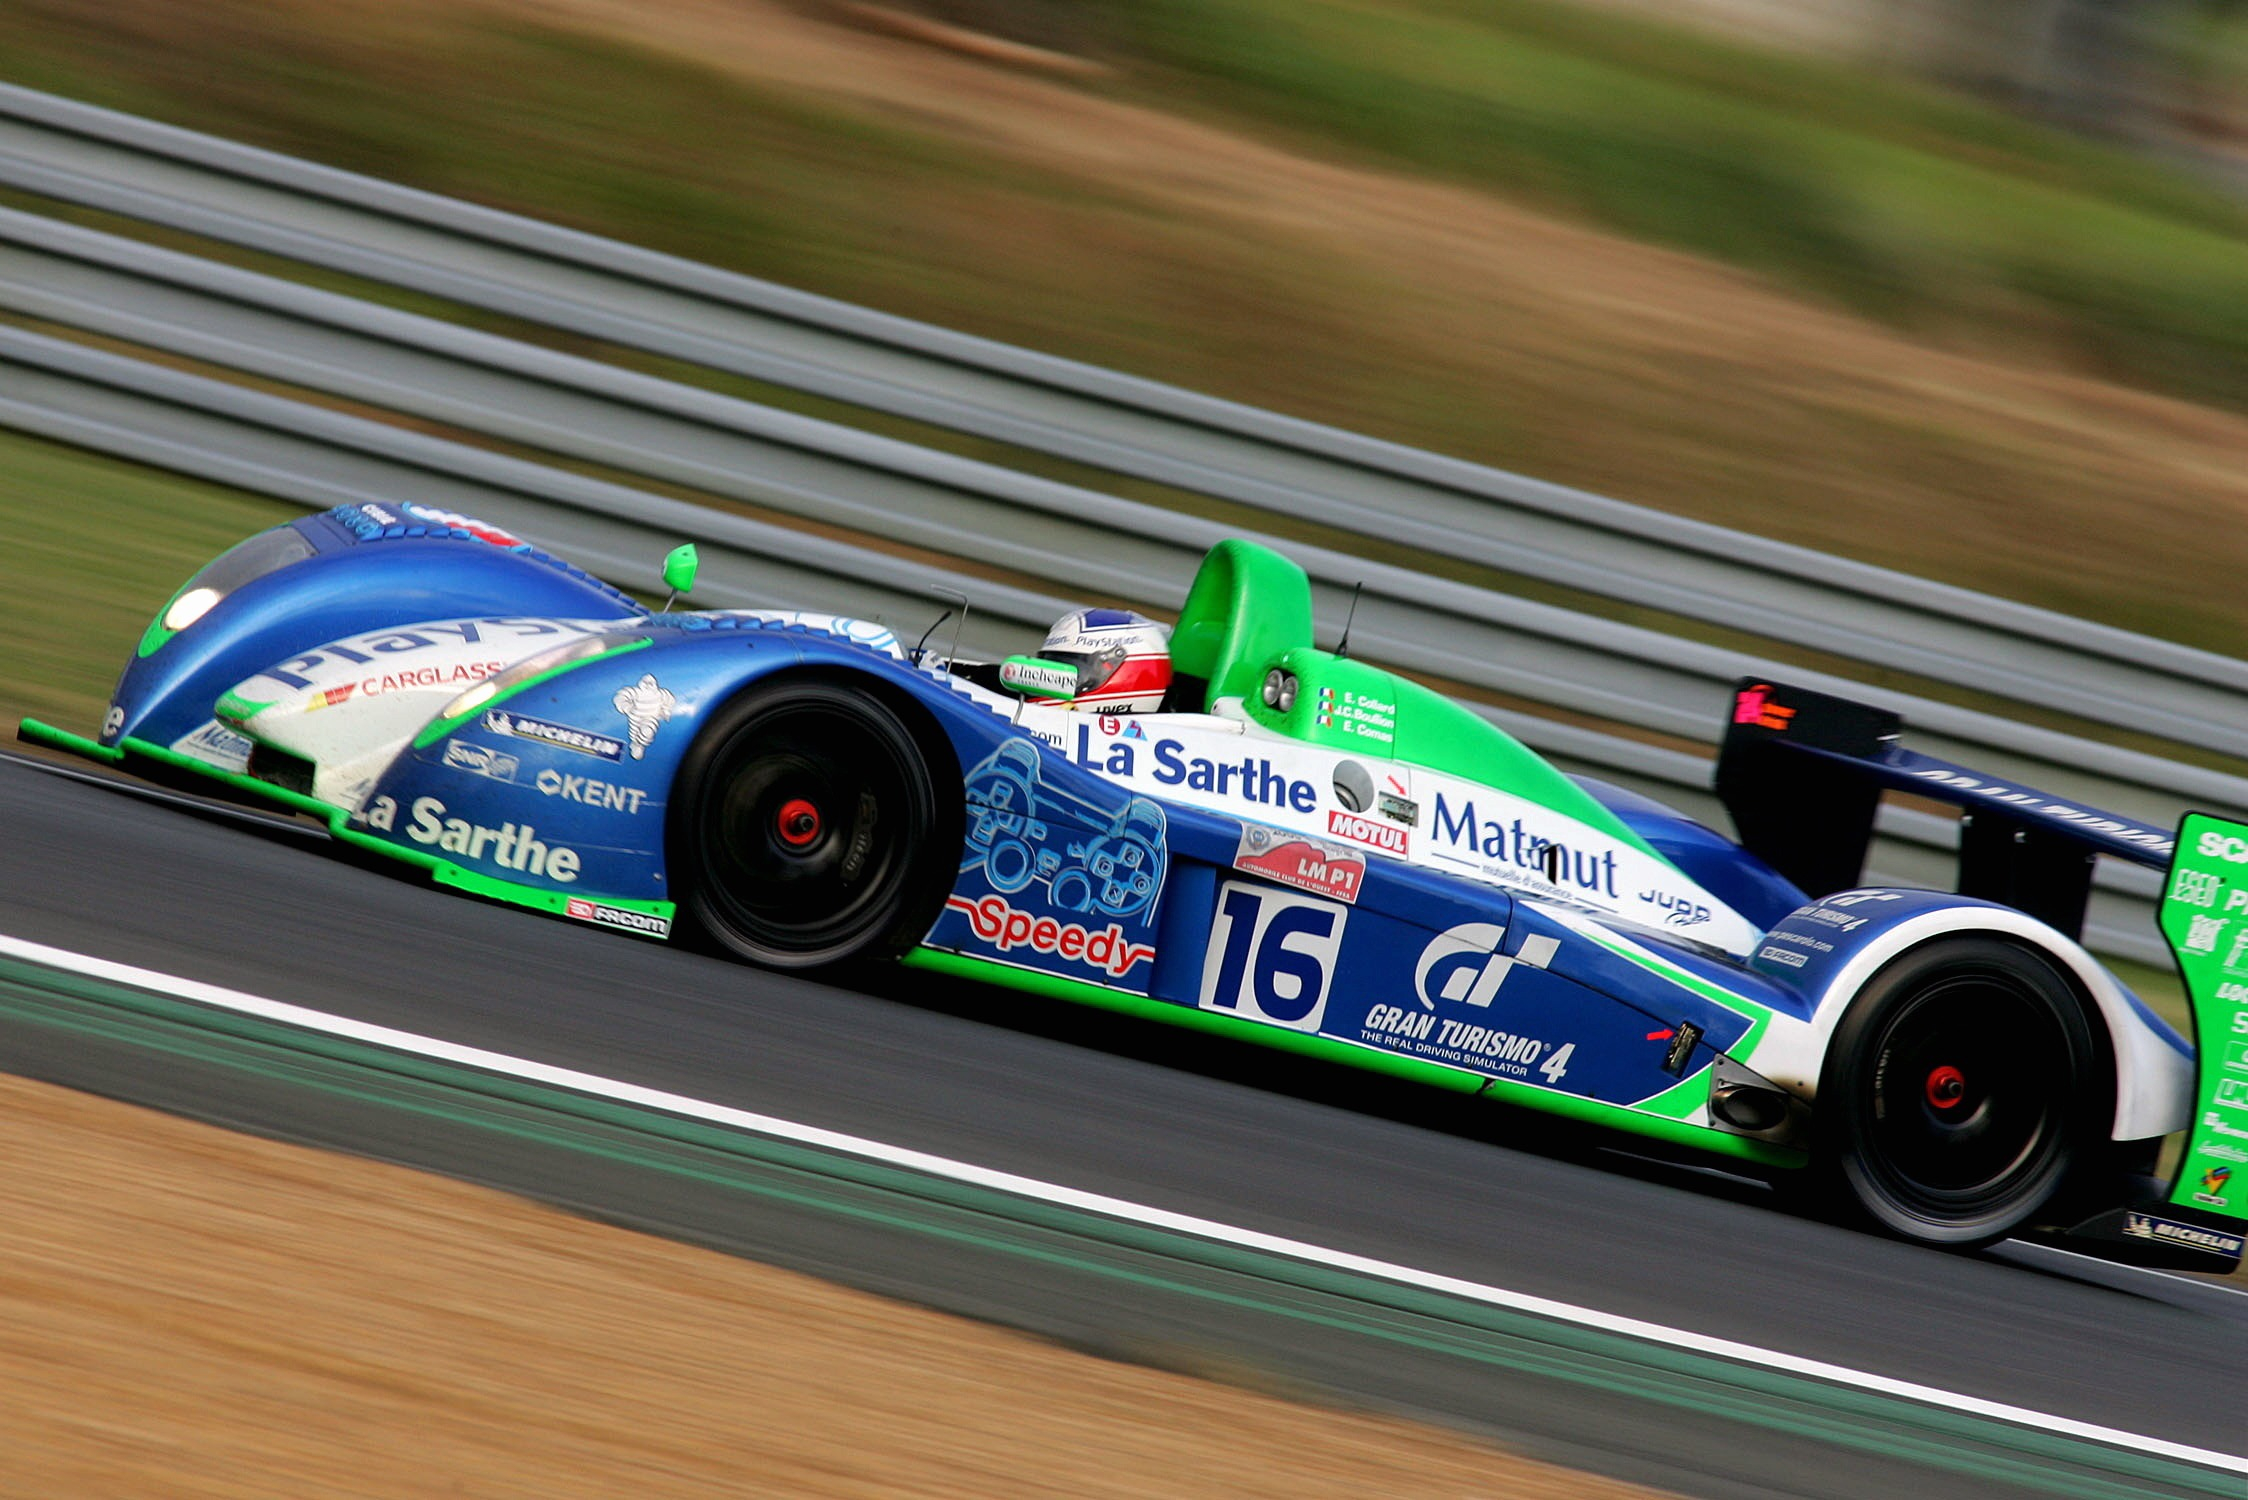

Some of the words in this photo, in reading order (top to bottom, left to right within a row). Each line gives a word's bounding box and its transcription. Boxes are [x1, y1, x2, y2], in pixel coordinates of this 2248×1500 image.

[361, 660, 503, 698] CARGLASS
[515, 719, 620, 756] MICHELIN
[1076, 723, 1135, 777] La
[1151, 738, 1318, 814] Sarthe
[560, 773, 647, 815] KENT
[404, 796, 582, 883] Sarthe
[1330, 814, 1407, 853] MOTUL
[1431, 791, 1620, 899] Matmut
[1242, 861, 1280, 878] AUTOMOBILE
[1281, 873, 1296, 884] CLUB
[1297, 858, 1327, 882] LM
[1329, 868, 1355, 889] P1
[970, 895, 1135, 975] Speedy
[1212, 888, 1336, 1022] 16
[1360, 1029, 1383, 1043] THE
[1384, 1036, 1413, 1051] REAL
[1415, 1042, 1461, 1062] DRIVING
[1462, 1054, 1528, 1077] SIMULATOR
[1365, 1003, 1437, 1041] GRAN
[1539, 1042, 1576, 1084] 4
[2153, 1222, 2242, 1252] MICHELIN
